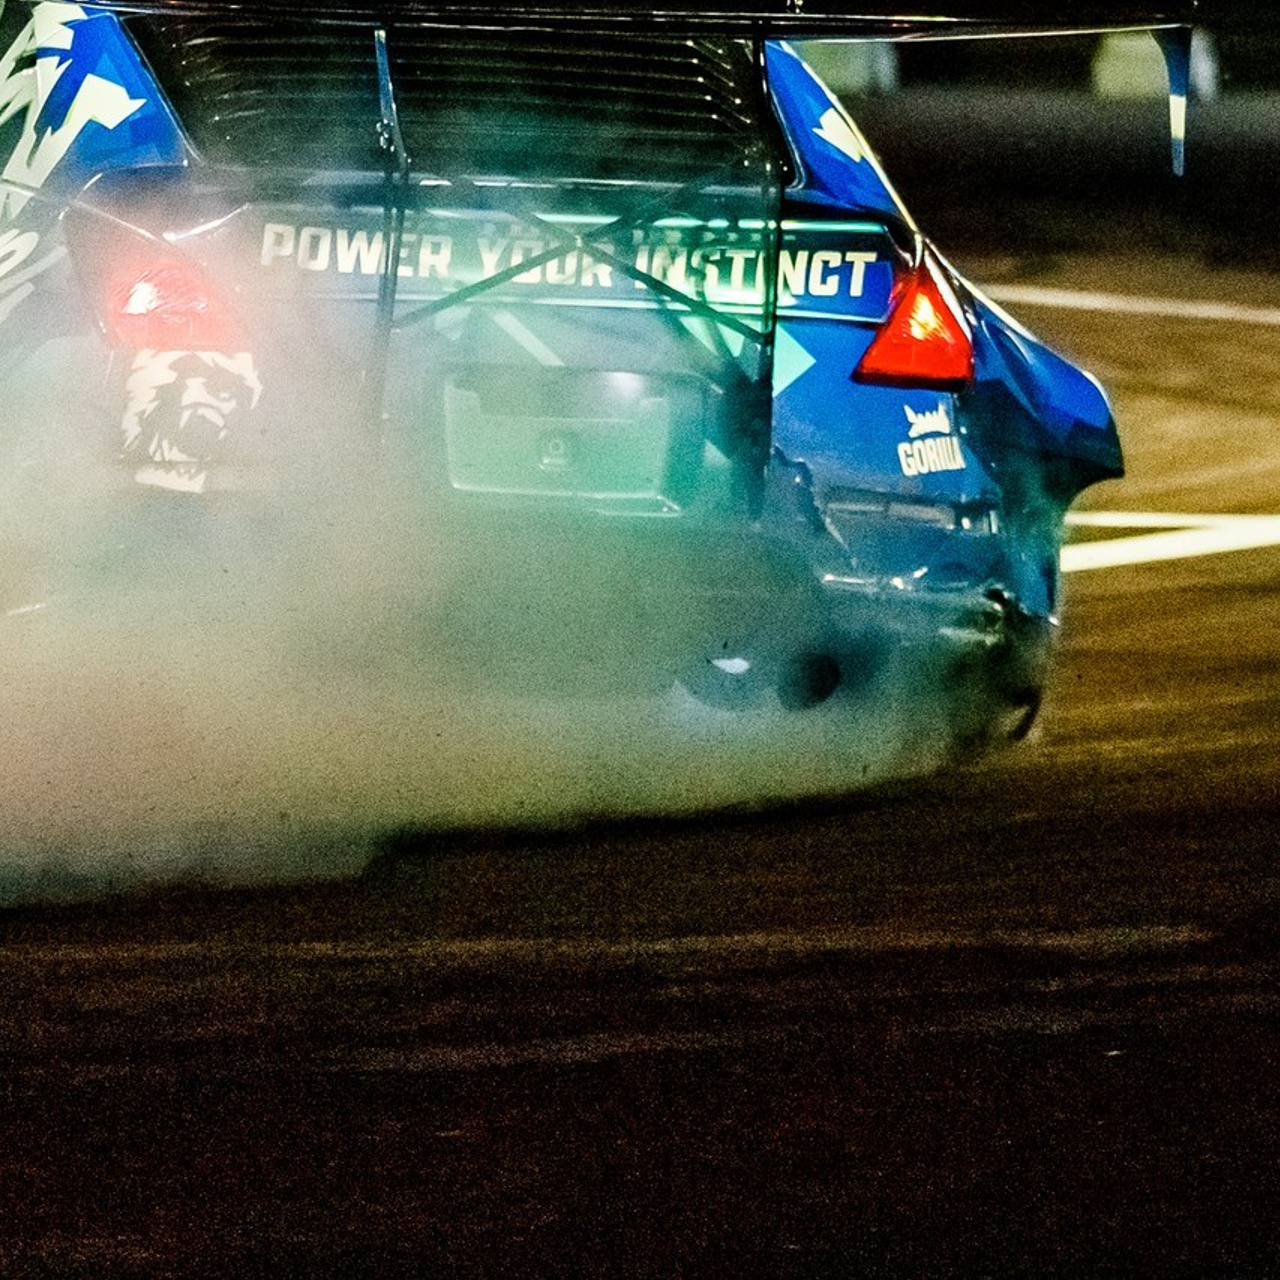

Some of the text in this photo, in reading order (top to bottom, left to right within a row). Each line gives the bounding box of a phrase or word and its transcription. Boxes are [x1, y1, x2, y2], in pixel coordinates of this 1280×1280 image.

[260, 223, 878, 298] POWER YOUR INSTINCT
[897, 436, 967, 476] GORILLA
